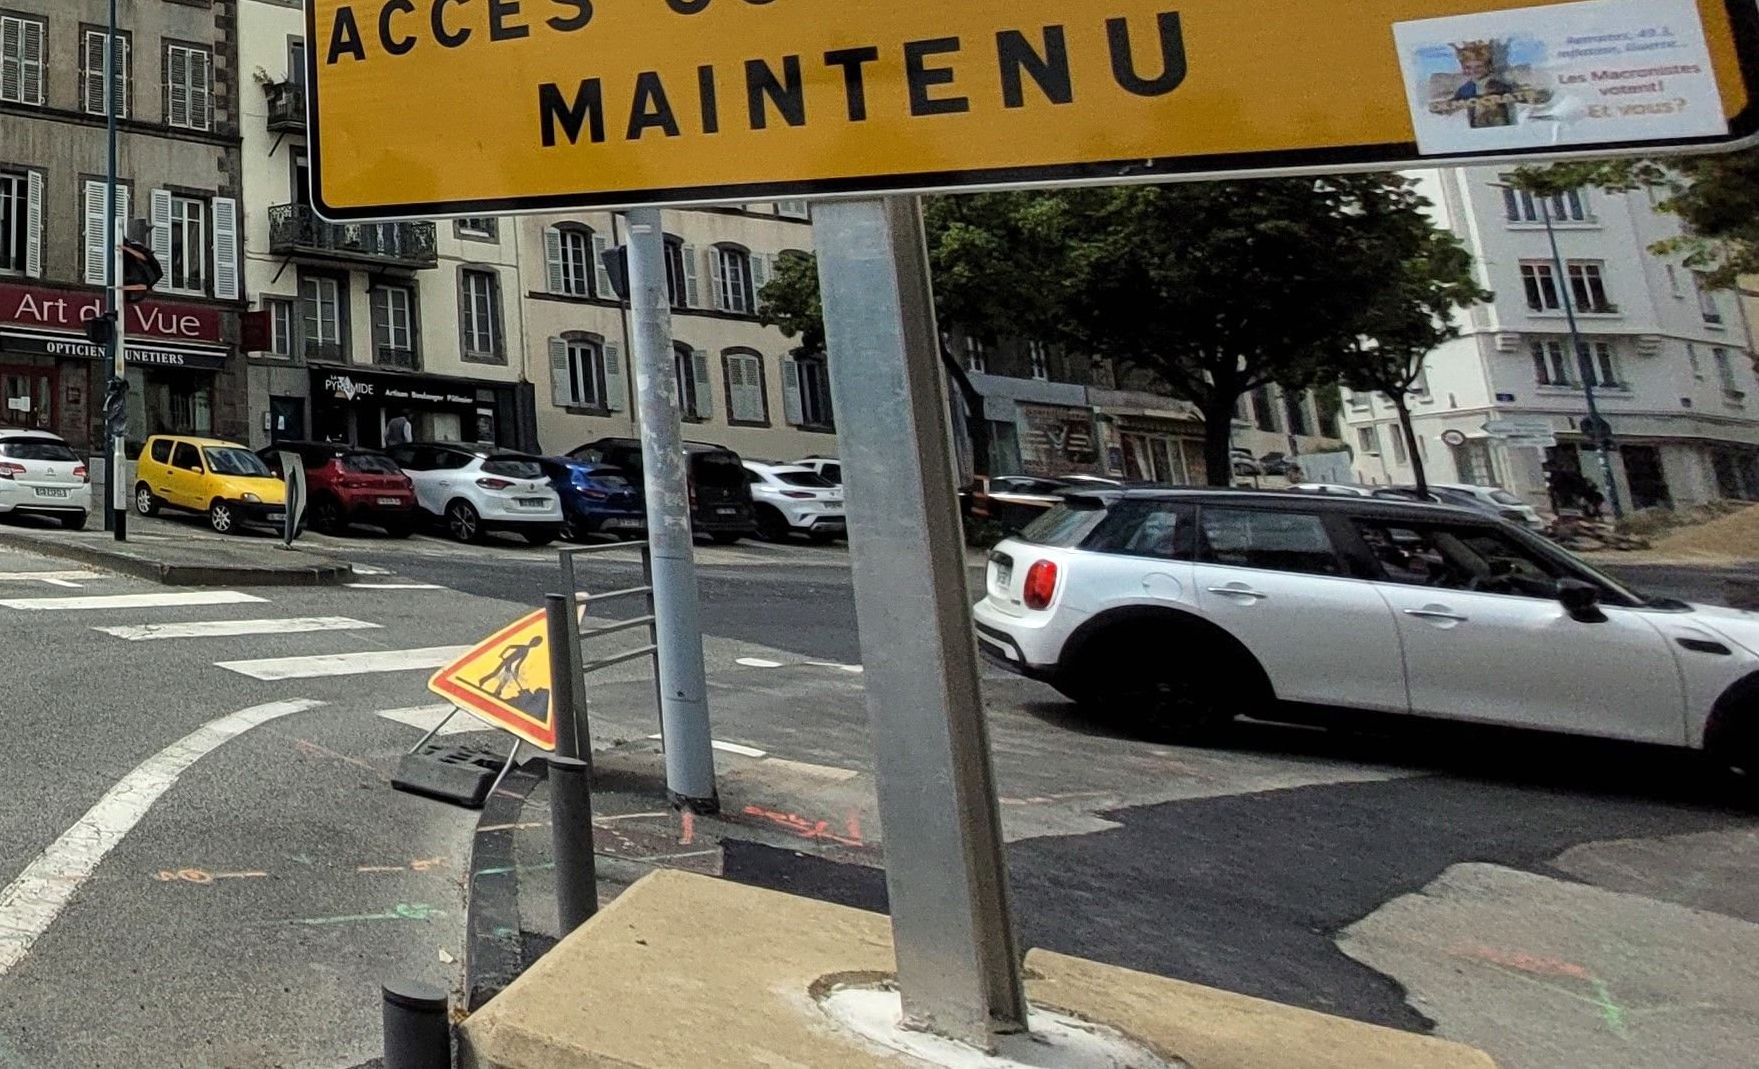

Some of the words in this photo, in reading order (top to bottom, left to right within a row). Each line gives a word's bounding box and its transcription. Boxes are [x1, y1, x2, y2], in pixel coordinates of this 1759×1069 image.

[538, 11, 1188, 147] MAINTENU
[1558, 73, 1587, 84] Les
[1591, 63, 1702, 82] Macronistes
[1598, 80, 1664, 96] votent!
[1586, 104, 1611, 118] Et
[1615, 97, 1687, 116] vous?
[14, 293, 67, 324] Art
[134, 304, 201, 337] Vue
[46, 341, 107, 358] OPTICIEN
[124, 350, 185, 365] UNETIERS
[325, 380, 374, 395] PYRAMIDE
[385, 388, 409, 398] Artisan
